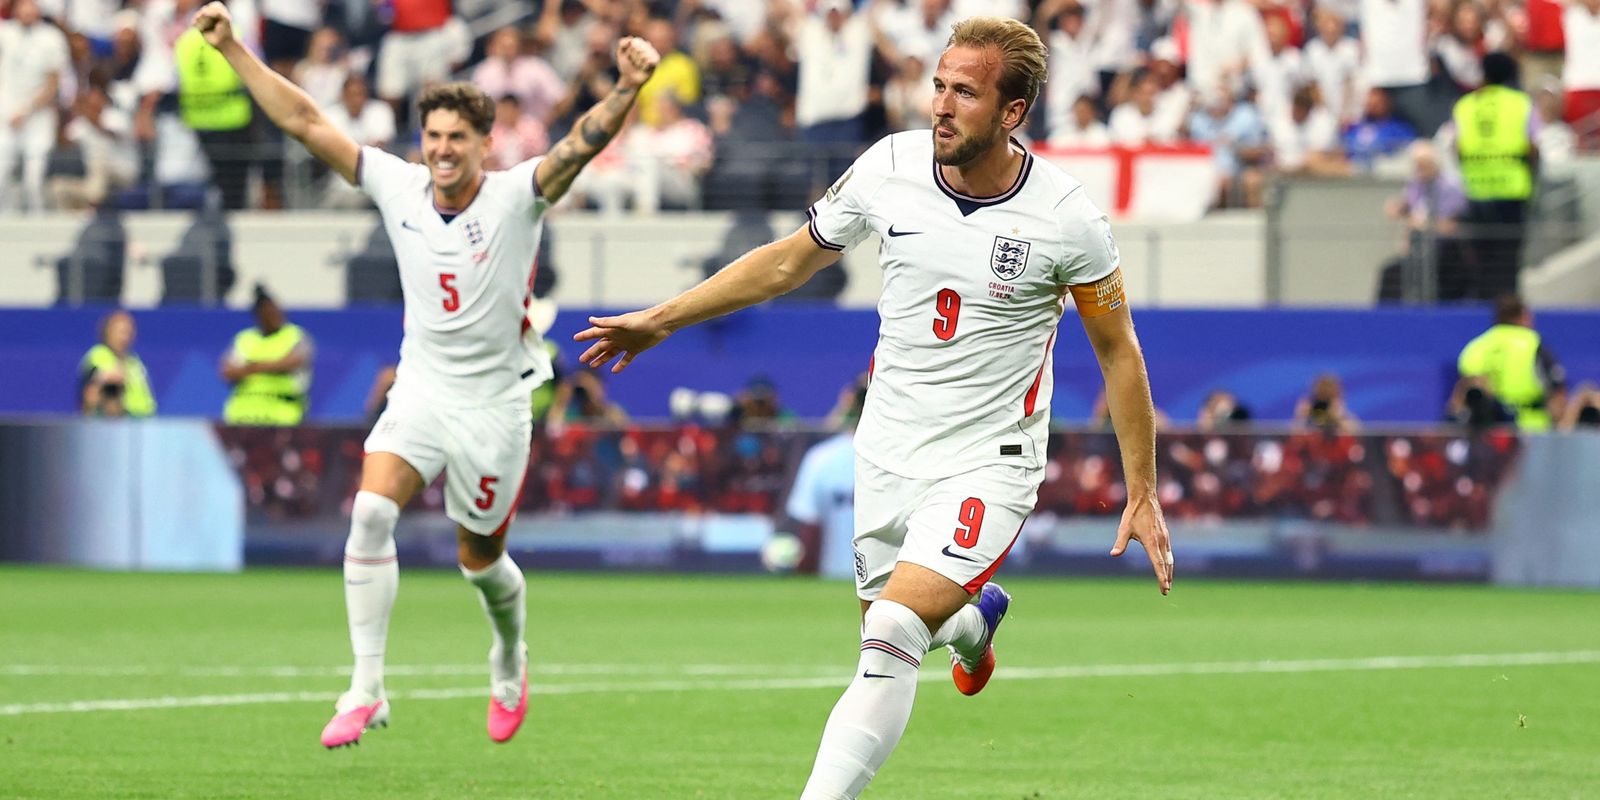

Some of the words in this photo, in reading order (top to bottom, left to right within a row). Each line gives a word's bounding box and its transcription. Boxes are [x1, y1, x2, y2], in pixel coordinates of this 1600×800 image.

[439, 272, 460, 313] 5
[988, 282, 1015, 293] CROATIA
[1097, 276, 1123, 298] UNITES
[933, 288, 961, 341] 9
[476, 476, 499, 511] 5
[953, 497, 986, 549] 9
